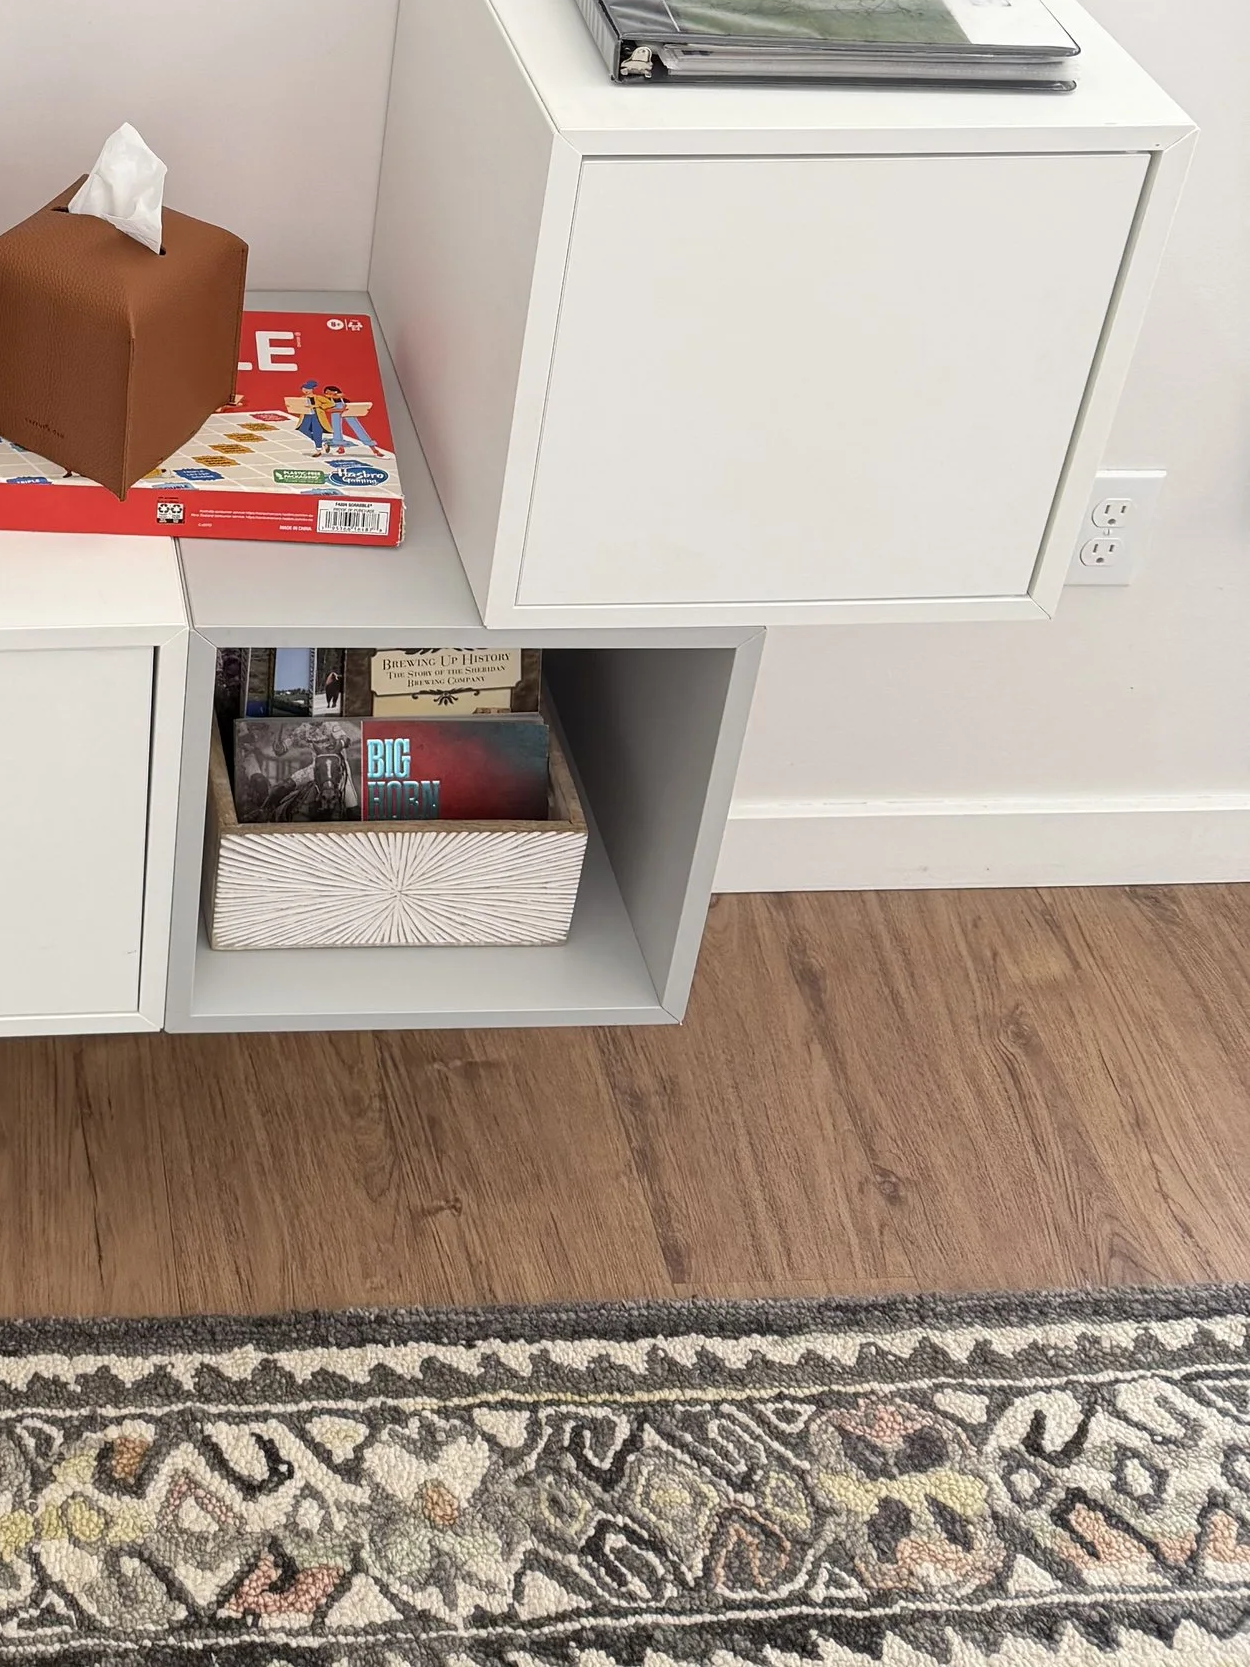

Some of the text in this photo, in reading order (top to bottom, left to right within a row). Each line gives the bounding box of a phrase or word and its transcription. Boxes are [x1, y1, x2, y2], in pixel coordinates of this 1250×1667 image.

[336, 467, 384, 479] Hasbro
[383, 652, 511, 671] BREWING UP HISTORY
[387, 671, 405, 680] THE
[407, 670, 432, 679] STORY
[447, 668, 463, 676] THE
[465, 665, 506, 674] SHERIDAN
[407, 675, 486, 687] BREWING COMPANY
[366, 738, 411, 779] BIG
[367, 780, 440, 820] HORN
